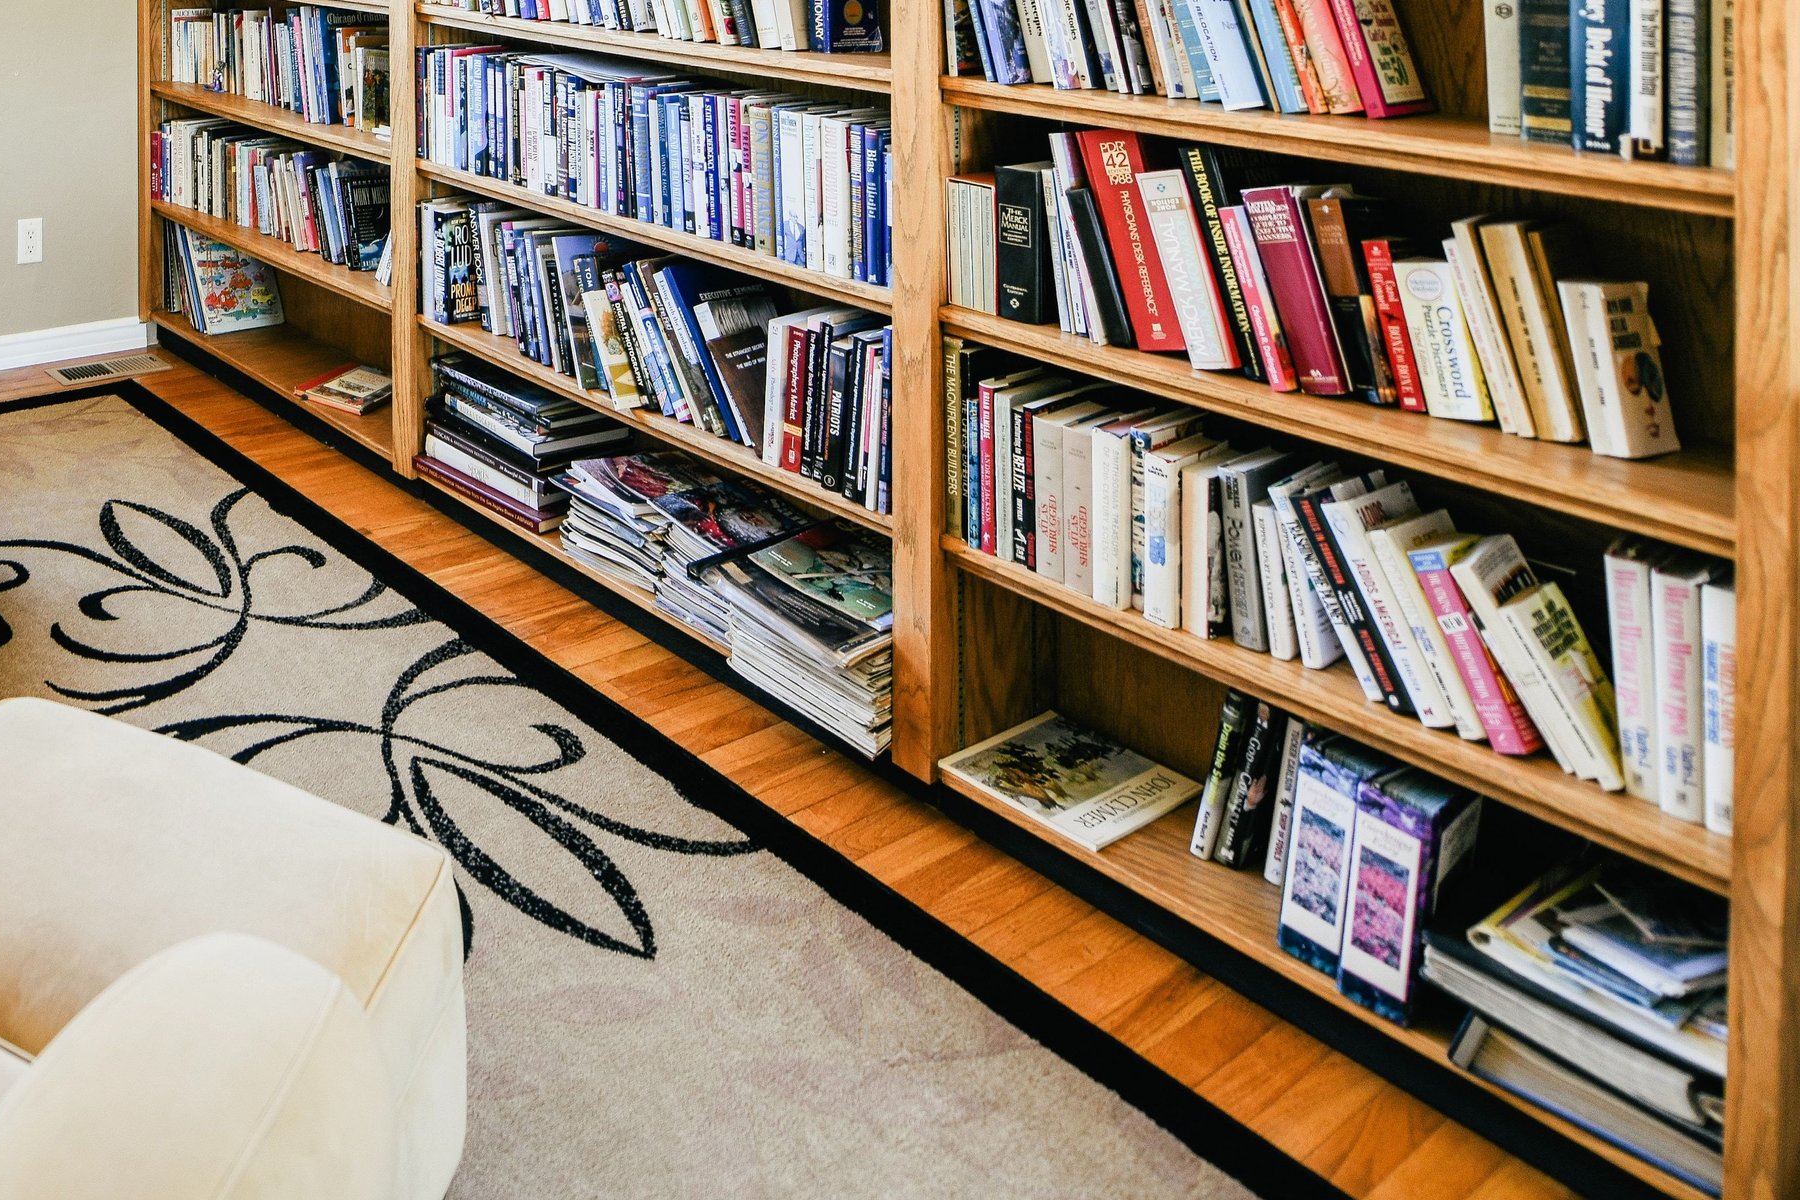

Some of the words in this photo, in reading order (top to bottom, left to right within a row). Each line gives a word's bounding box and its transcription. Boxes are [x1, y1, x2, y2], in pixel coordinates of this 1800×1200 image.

[327, 13, 356, 25] Chicago
[1065, 11, 1079, 41] Stories
[1194, 4, 1218, 63] RELOCATION
[1584, 25, 1613, 66] Debt
[1585, 65, 1613, 85] of
[727, 103, 738, 144] TREASON
[1585, 84, 1613, 138] Honor
[753, 119, 769, 144] ON
[705, 133, 715, 170] EMERGENCY
[754, 148, 771, 182] THE
[865, 147, 877, 174] Bias
[1106, 152, 1129, 168] 42
[1186, 147, 1205, 174] THE
[1109, 173, 1133, 185] 1988
[1193, 171, 1214, 204] BOOK
[756, 184, 773, 237] MAKE
[1001, 221, 1028, 232] MANUAL
[1002, 213, 1028, 224] MERCK
[1115, 188, 1144, 243] PHYSICIANS'
[1202, 201, 1218, 220] OF
[466, 207, 481, 251] ANSWER
[1207, 217, 1229, 256] INSIDE
[471, 251, 484, 283] BOOK
[1130, 240, 1147, 266] DESK
[1158, 216, 1188, 294] MANUAL
[584, 267, 594, 289] TOM
[1133, 264, 1160, 315] REFERENCE
[1218, 254, 1252, 334] INFORMATION
[656, 278, 671, 301] Living
[666, 299, 677, 315] with
[612, 301, 628, 331] DIGITAL
[620, 331, 646, 387] PHOTOGRAPHY
[1433, 303, 1474, 402] Crossword
[788, 339, 801, 393] Photographer's
[945, 352, 956, 373] THE
[788, 393, 799, 420] Market
[827, 389, 843, 436] PATRIOTS
[944, 375, 958, 443] MAGNIFICENT
[981, 409, 992, 440] KILMEADE
[1012, 412, 1023, 447] Adventuring
[946, 446, 958, 495] BUILDERS
[1011, 452, 1025, 493] BELIZE
[982, 486, 993, 522] JACKSON
[1037, 502, 1052, 536] ATLAS
[1041, 493, 1064, 554] SHRUGGED
[1067, 514, 1080, 549] ATLAS
[1073, 505, 1093, 567] SHRUGGED
[1219, 723, 1233, 748] Drain
[1216, 750, 1227, 764] the
[1286, 756, 1296, 793] CARLSON
[1131, 773, 1176, 800] JOHN
[1073, 794, 1138, 828] CLYMER
[1274, 835, 1283, 862] FOOLS
